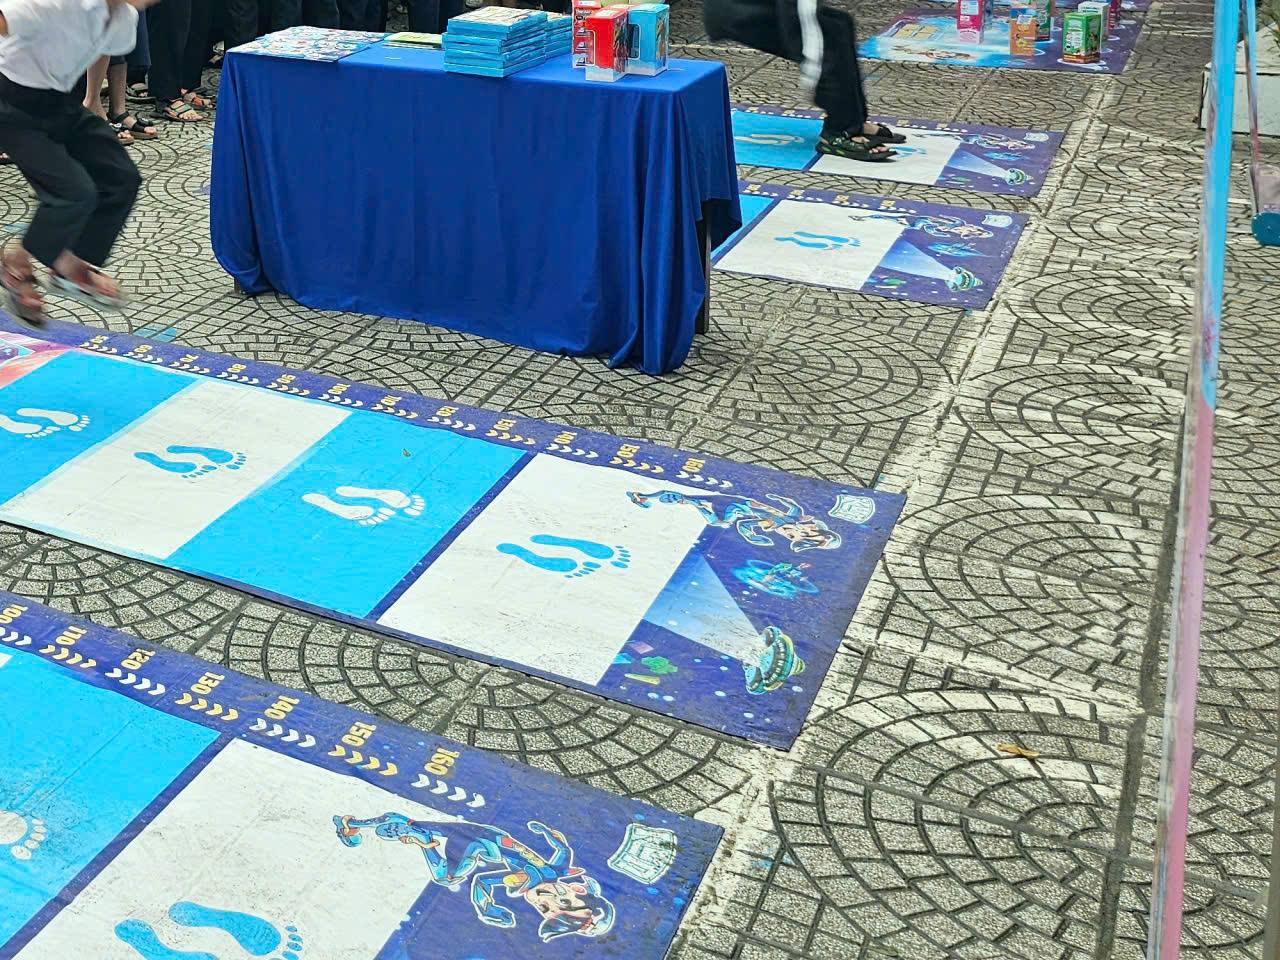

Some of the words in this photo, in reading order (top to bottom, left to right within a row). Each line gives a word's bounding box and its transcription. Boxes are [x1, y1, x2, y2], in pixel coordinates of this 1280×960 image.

[55, 625, 87, 646] 110
[122, 648, 155, 670] 120
[191, 671, 224, 695] 130
[264, 695, 298, 720] 140
[343, 721, 376, 747] 150
[424, 746, 460, 776] 160
